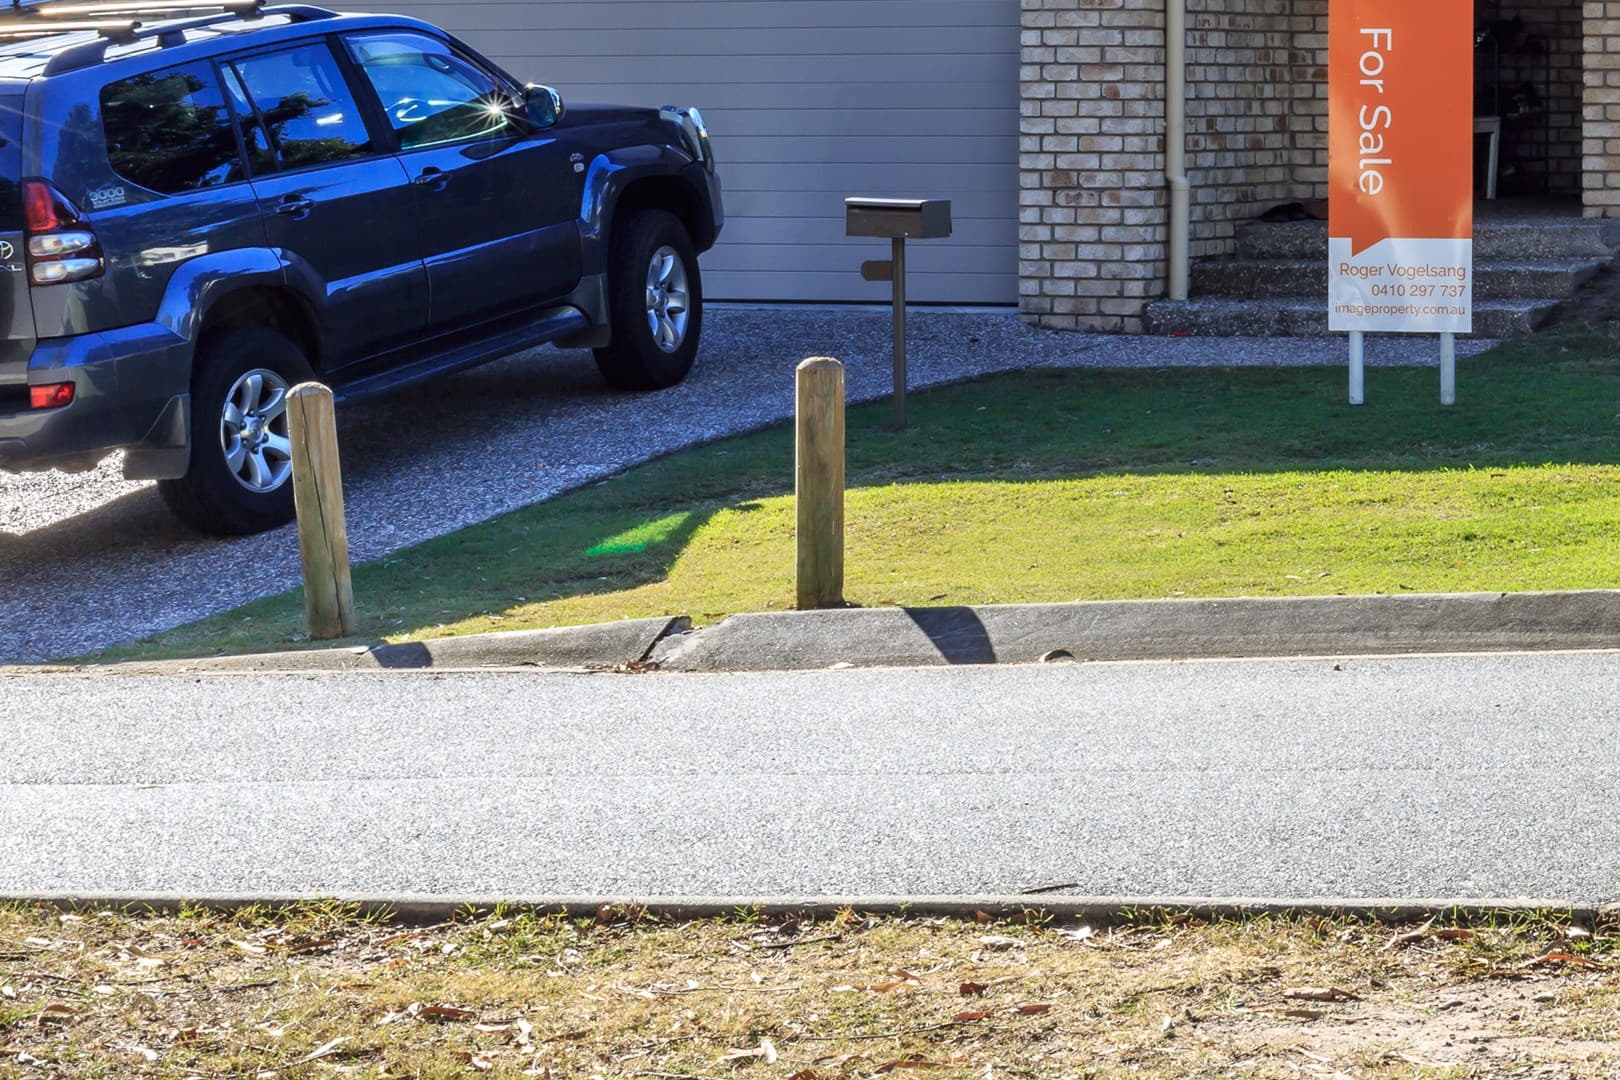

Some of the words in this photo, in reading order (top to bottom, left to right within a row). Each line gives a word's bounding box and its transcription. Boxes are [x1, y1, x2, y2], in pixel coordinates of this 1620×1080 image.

[1359, 28, 1392, 94] For
[1359, 104, 1392, 195] Sale
[1339, 262, 1384, 280] Roger
[1387, 263, 1466, 281] Vogelsang
[1371, 284, 1406, 297] 0410
[1409, 284, 1436, 297] 297
[1440, 285, 1466, 297] 737
[1335, 303, 1465, 316] imageproperty.com.au
